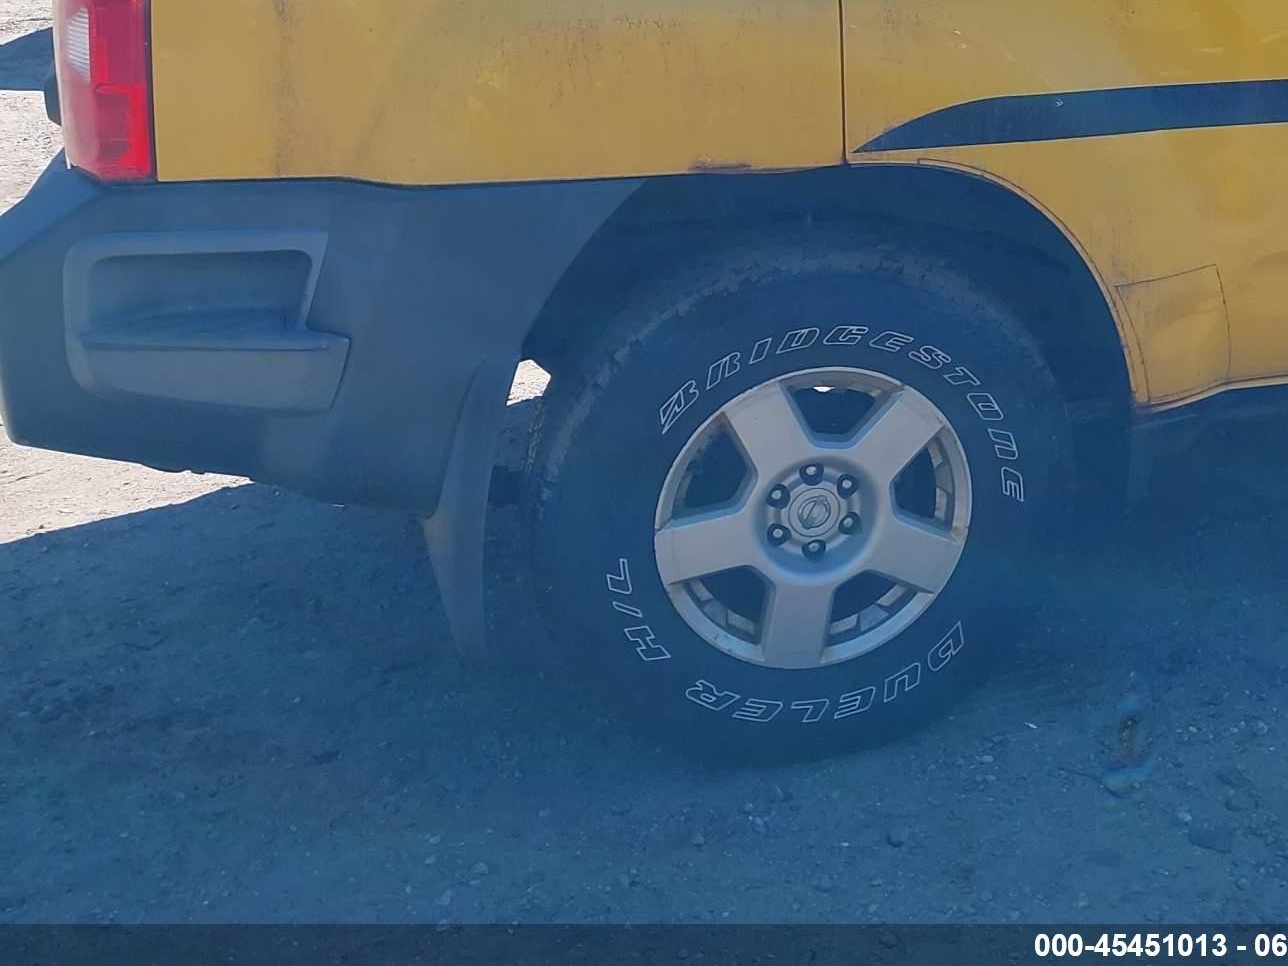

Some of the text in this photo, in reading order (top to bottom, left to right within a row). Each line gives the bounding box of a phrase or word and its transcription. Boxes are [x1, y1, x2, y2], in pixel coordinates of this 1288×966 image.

[659, 324, 1026, 503] BRIDGESTONE
[606, 557, 965, 724] DUELER H/L
